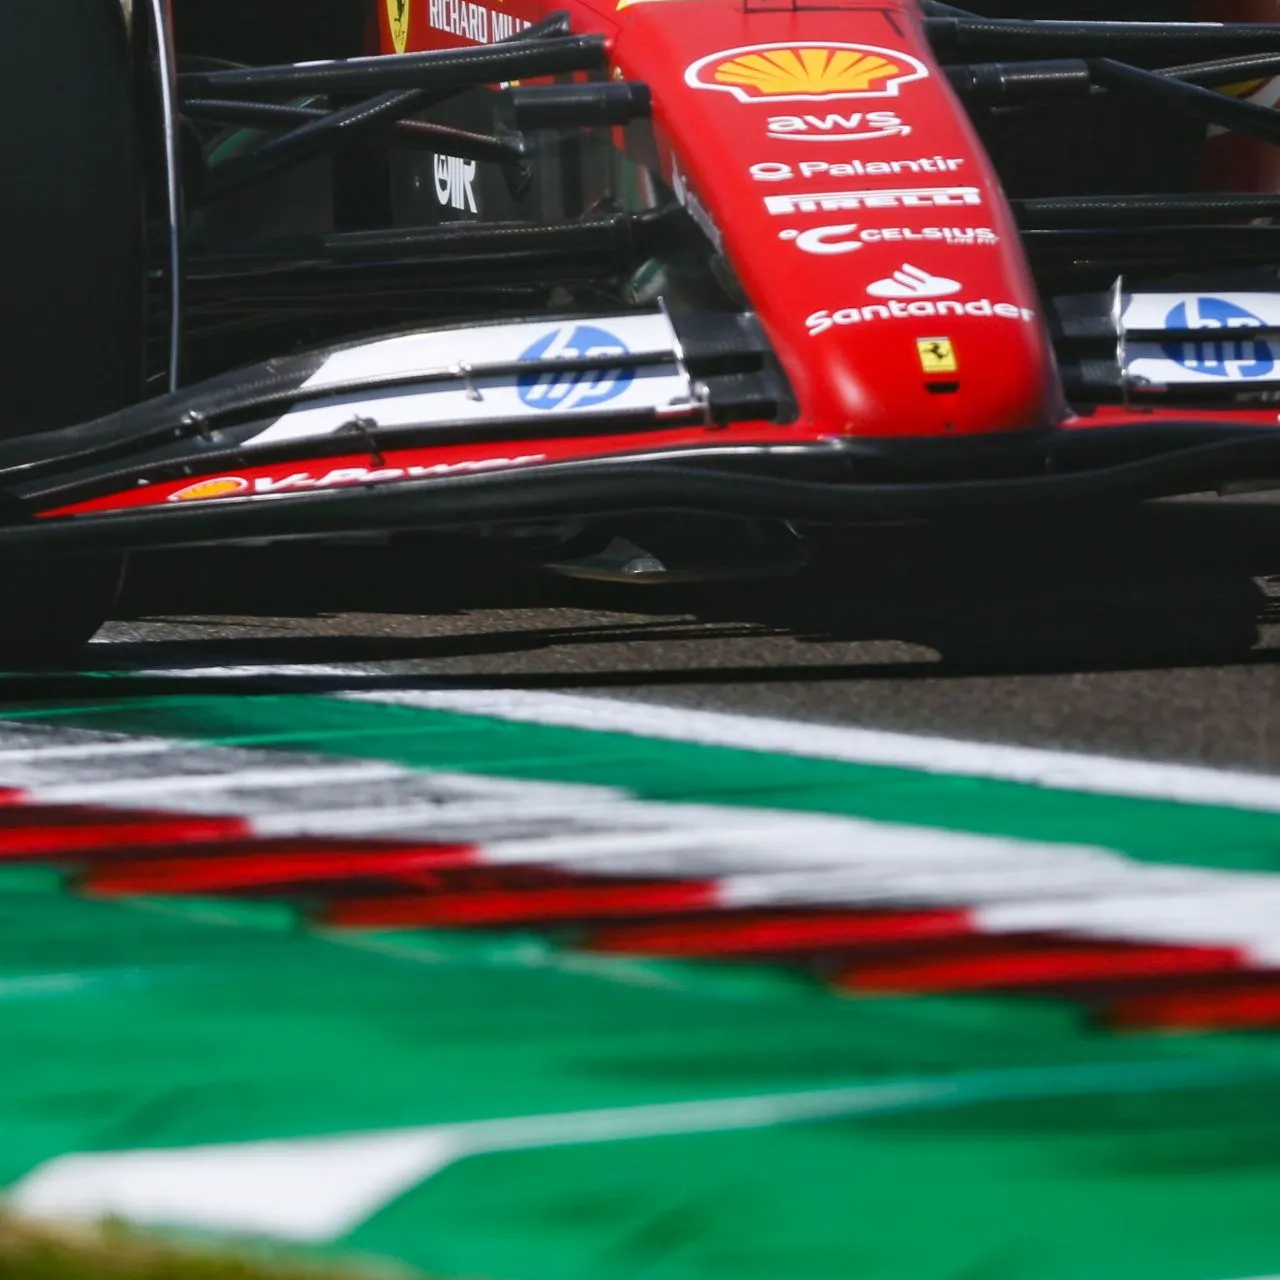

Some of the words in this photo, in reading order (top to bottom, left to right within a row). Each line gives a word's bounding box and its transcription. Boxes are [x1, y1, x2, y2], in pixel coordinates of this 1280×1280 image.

[767, 111, 903, 132] aws
[800, 156, 964, 178] Palantir
[763, 187, 982, 215] PIRELLI
[859, 227, 995, 243] CELSIUS
[804, 299, 1034, 336] Santander
